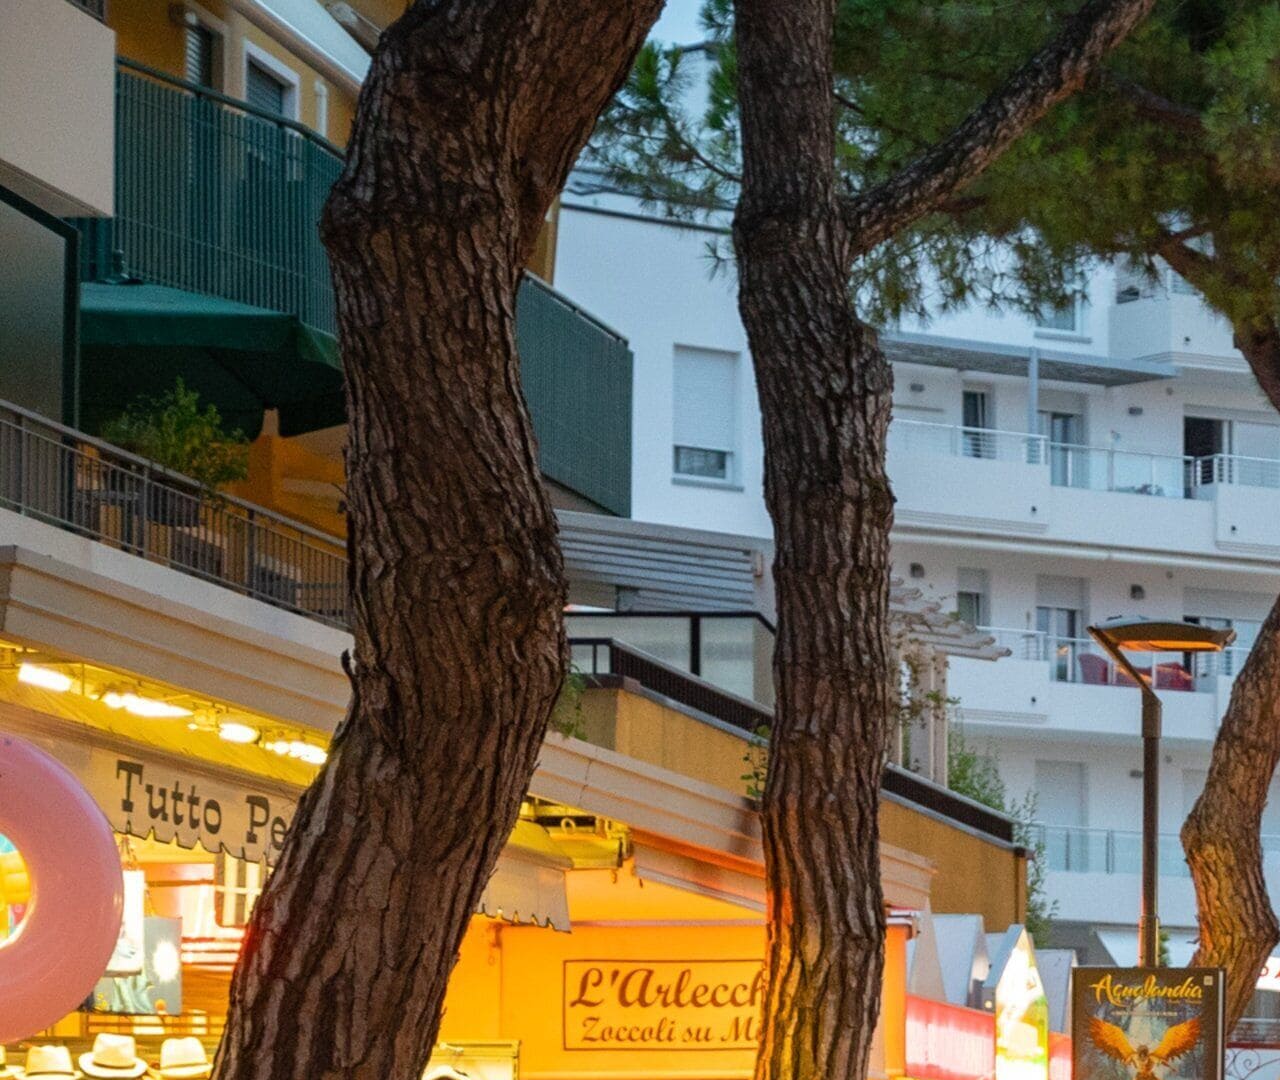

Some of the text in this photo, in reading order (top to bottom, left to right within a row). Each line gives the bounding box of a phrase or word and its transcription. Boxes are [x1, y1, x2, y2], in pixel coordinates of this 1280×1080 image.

[117, 759, 222, 835] Tutto
[1089, 974, 1203, 1007] Aqualandia
[582, 1016, 676, 1042] Zoccoli
[682, 1026, 713, 1042] su
